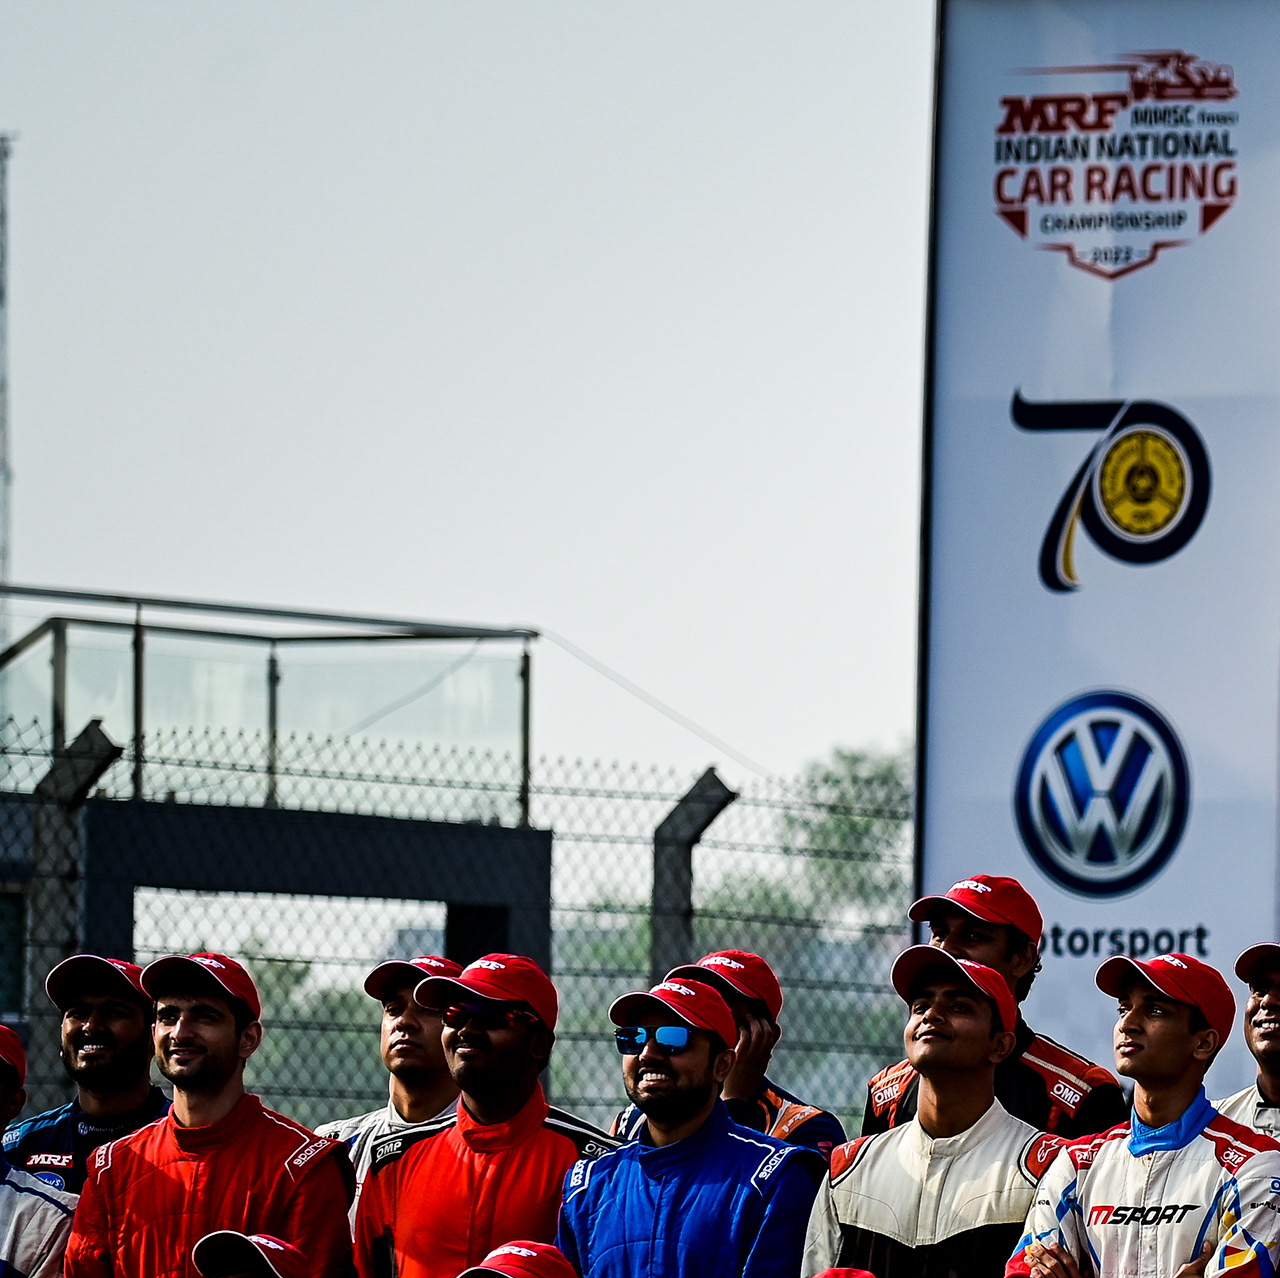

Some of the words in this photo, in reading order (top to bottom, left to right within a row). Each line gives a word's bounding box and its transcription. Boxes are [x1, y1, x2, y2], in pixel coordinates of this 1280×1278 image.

[997, 94, 1128, 134] MRF
[995, 135, 1089, 163] INDIAN
[1097, 131, 1237, 159] NATIONAL
[994, 165, 1074, 205] CAR
[1084, 161, 1238, 204] RACING
[1040, 210, 1187, 234] CHAMPIONSHIP
[1041, 922, 1209, 959] torsport
[874, 1084, 900, 1103] OMP
[1053, 1084, 1082, 1104] OMP
[29, 1154, 72, 1166] MRF
[293, 1138, 330, 1166] sparco
[376, 1142, 401, 1158] OMP
[585, 1144, 607, 1156] OM
[1221, 1151, 1244, 1164] OMP
